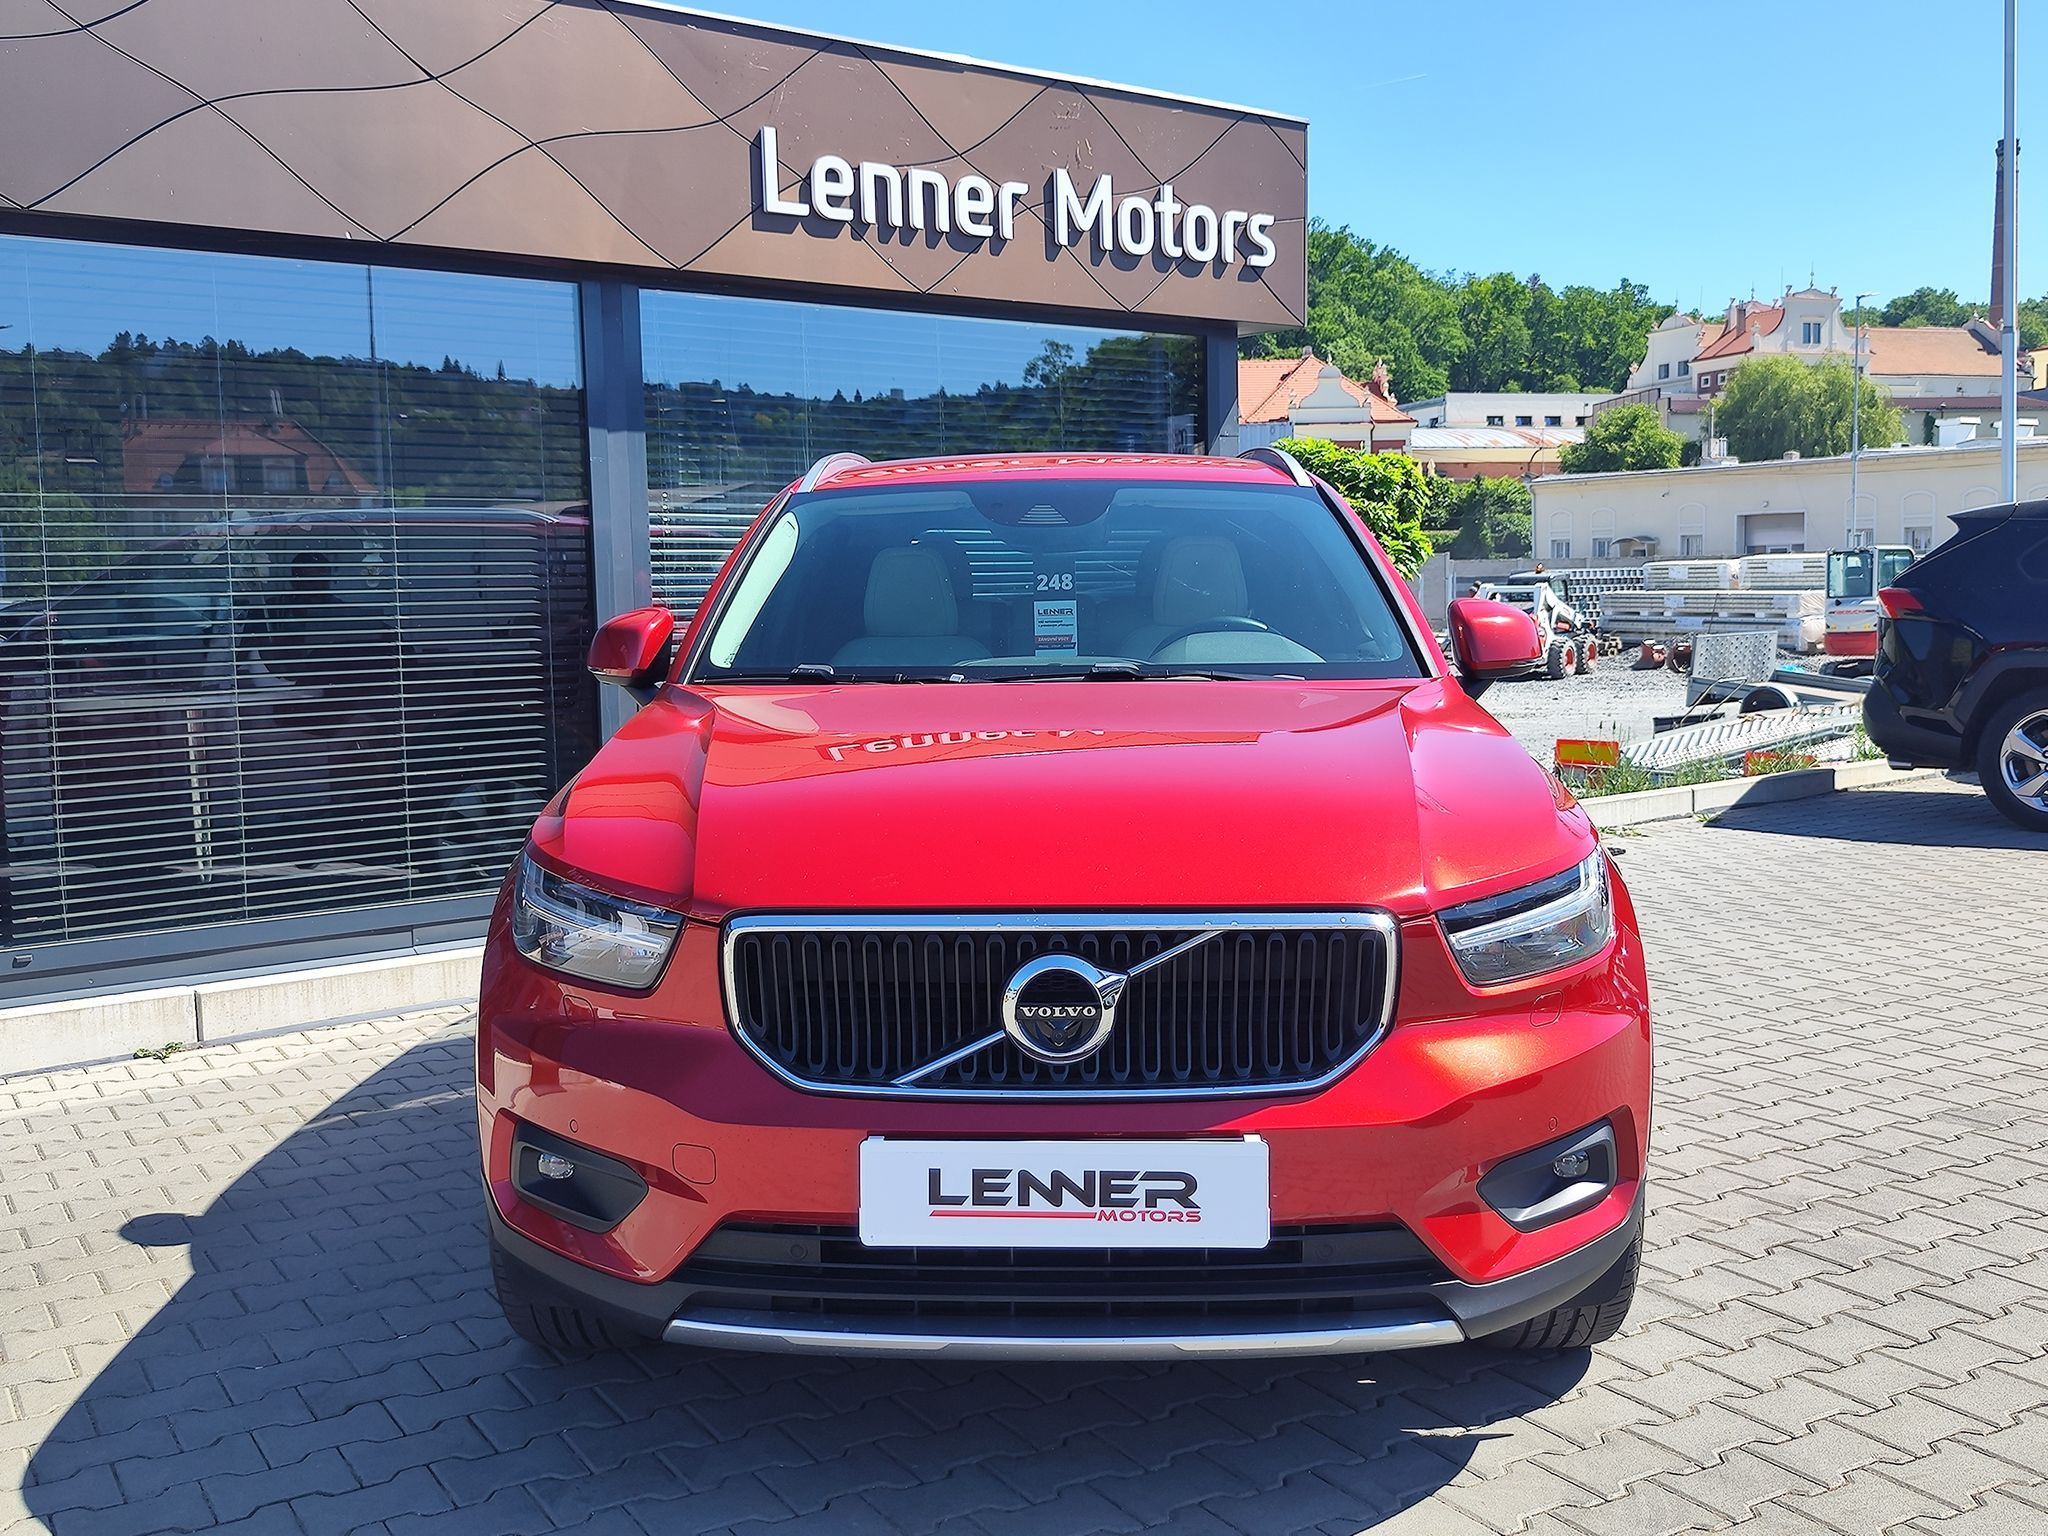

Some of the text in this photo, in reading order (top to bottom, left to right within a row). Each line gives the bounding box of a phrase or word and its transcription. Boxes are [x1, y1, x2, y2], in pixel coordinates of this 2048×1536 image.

[762, 125, 1277, 268] Lenner Motors
[1036, 573, 1074, 591] 248
[1037, 607, 1074, 616] LENNER
[1019, 1006, 1097, 1017] VOLVO
[927, 1167, 1201, 1209] LENNER
[1096, 1208, 1202, 1223] MOTORS
